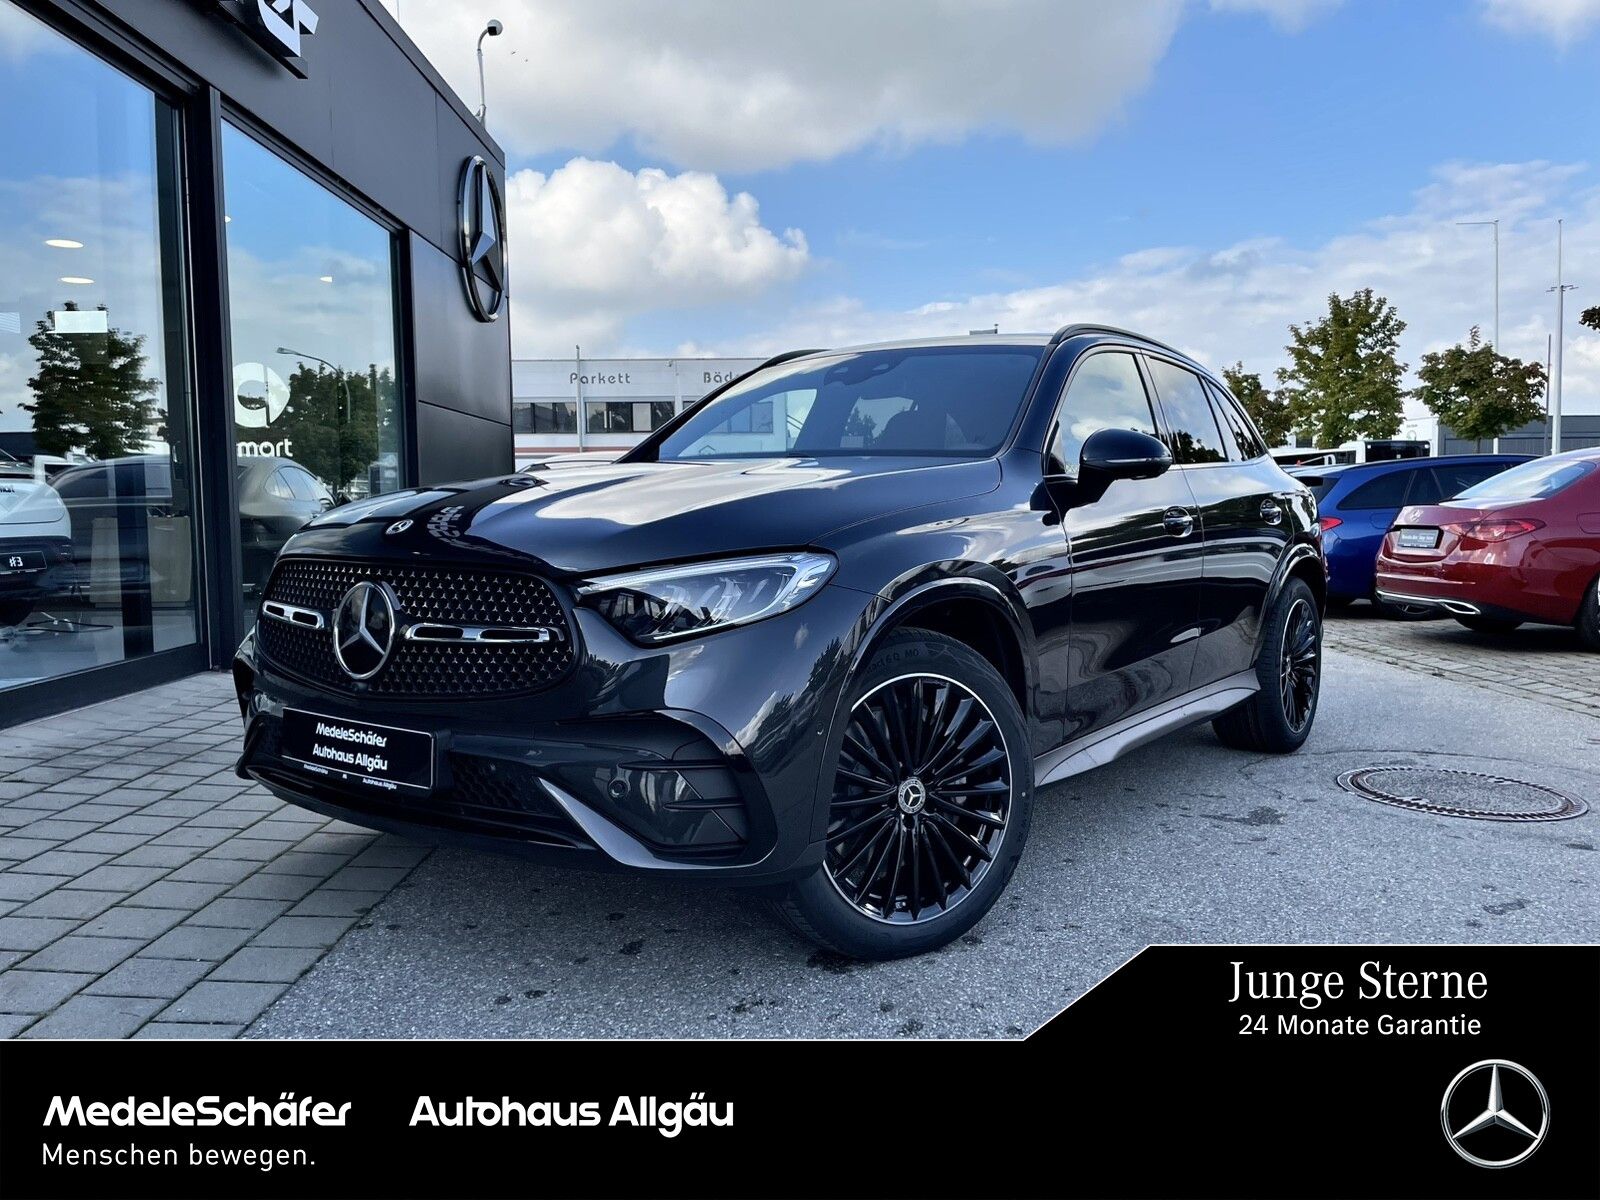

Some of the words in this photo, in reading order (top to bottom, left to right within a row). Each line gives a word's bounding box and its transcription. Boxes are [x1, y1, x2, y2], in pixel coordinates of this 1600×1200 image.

[570, 372, 631, 385] Parkett
[703, 371, 740, 383] Bäd
[236, 438, 294, 457] mart
[9, 556, 24, 567] #3
[315, 722, 388, 748] MedeleSchäfer
[312, 743, 354, 764] Autohaus
[355, 752, 388, 772] Allgäu
